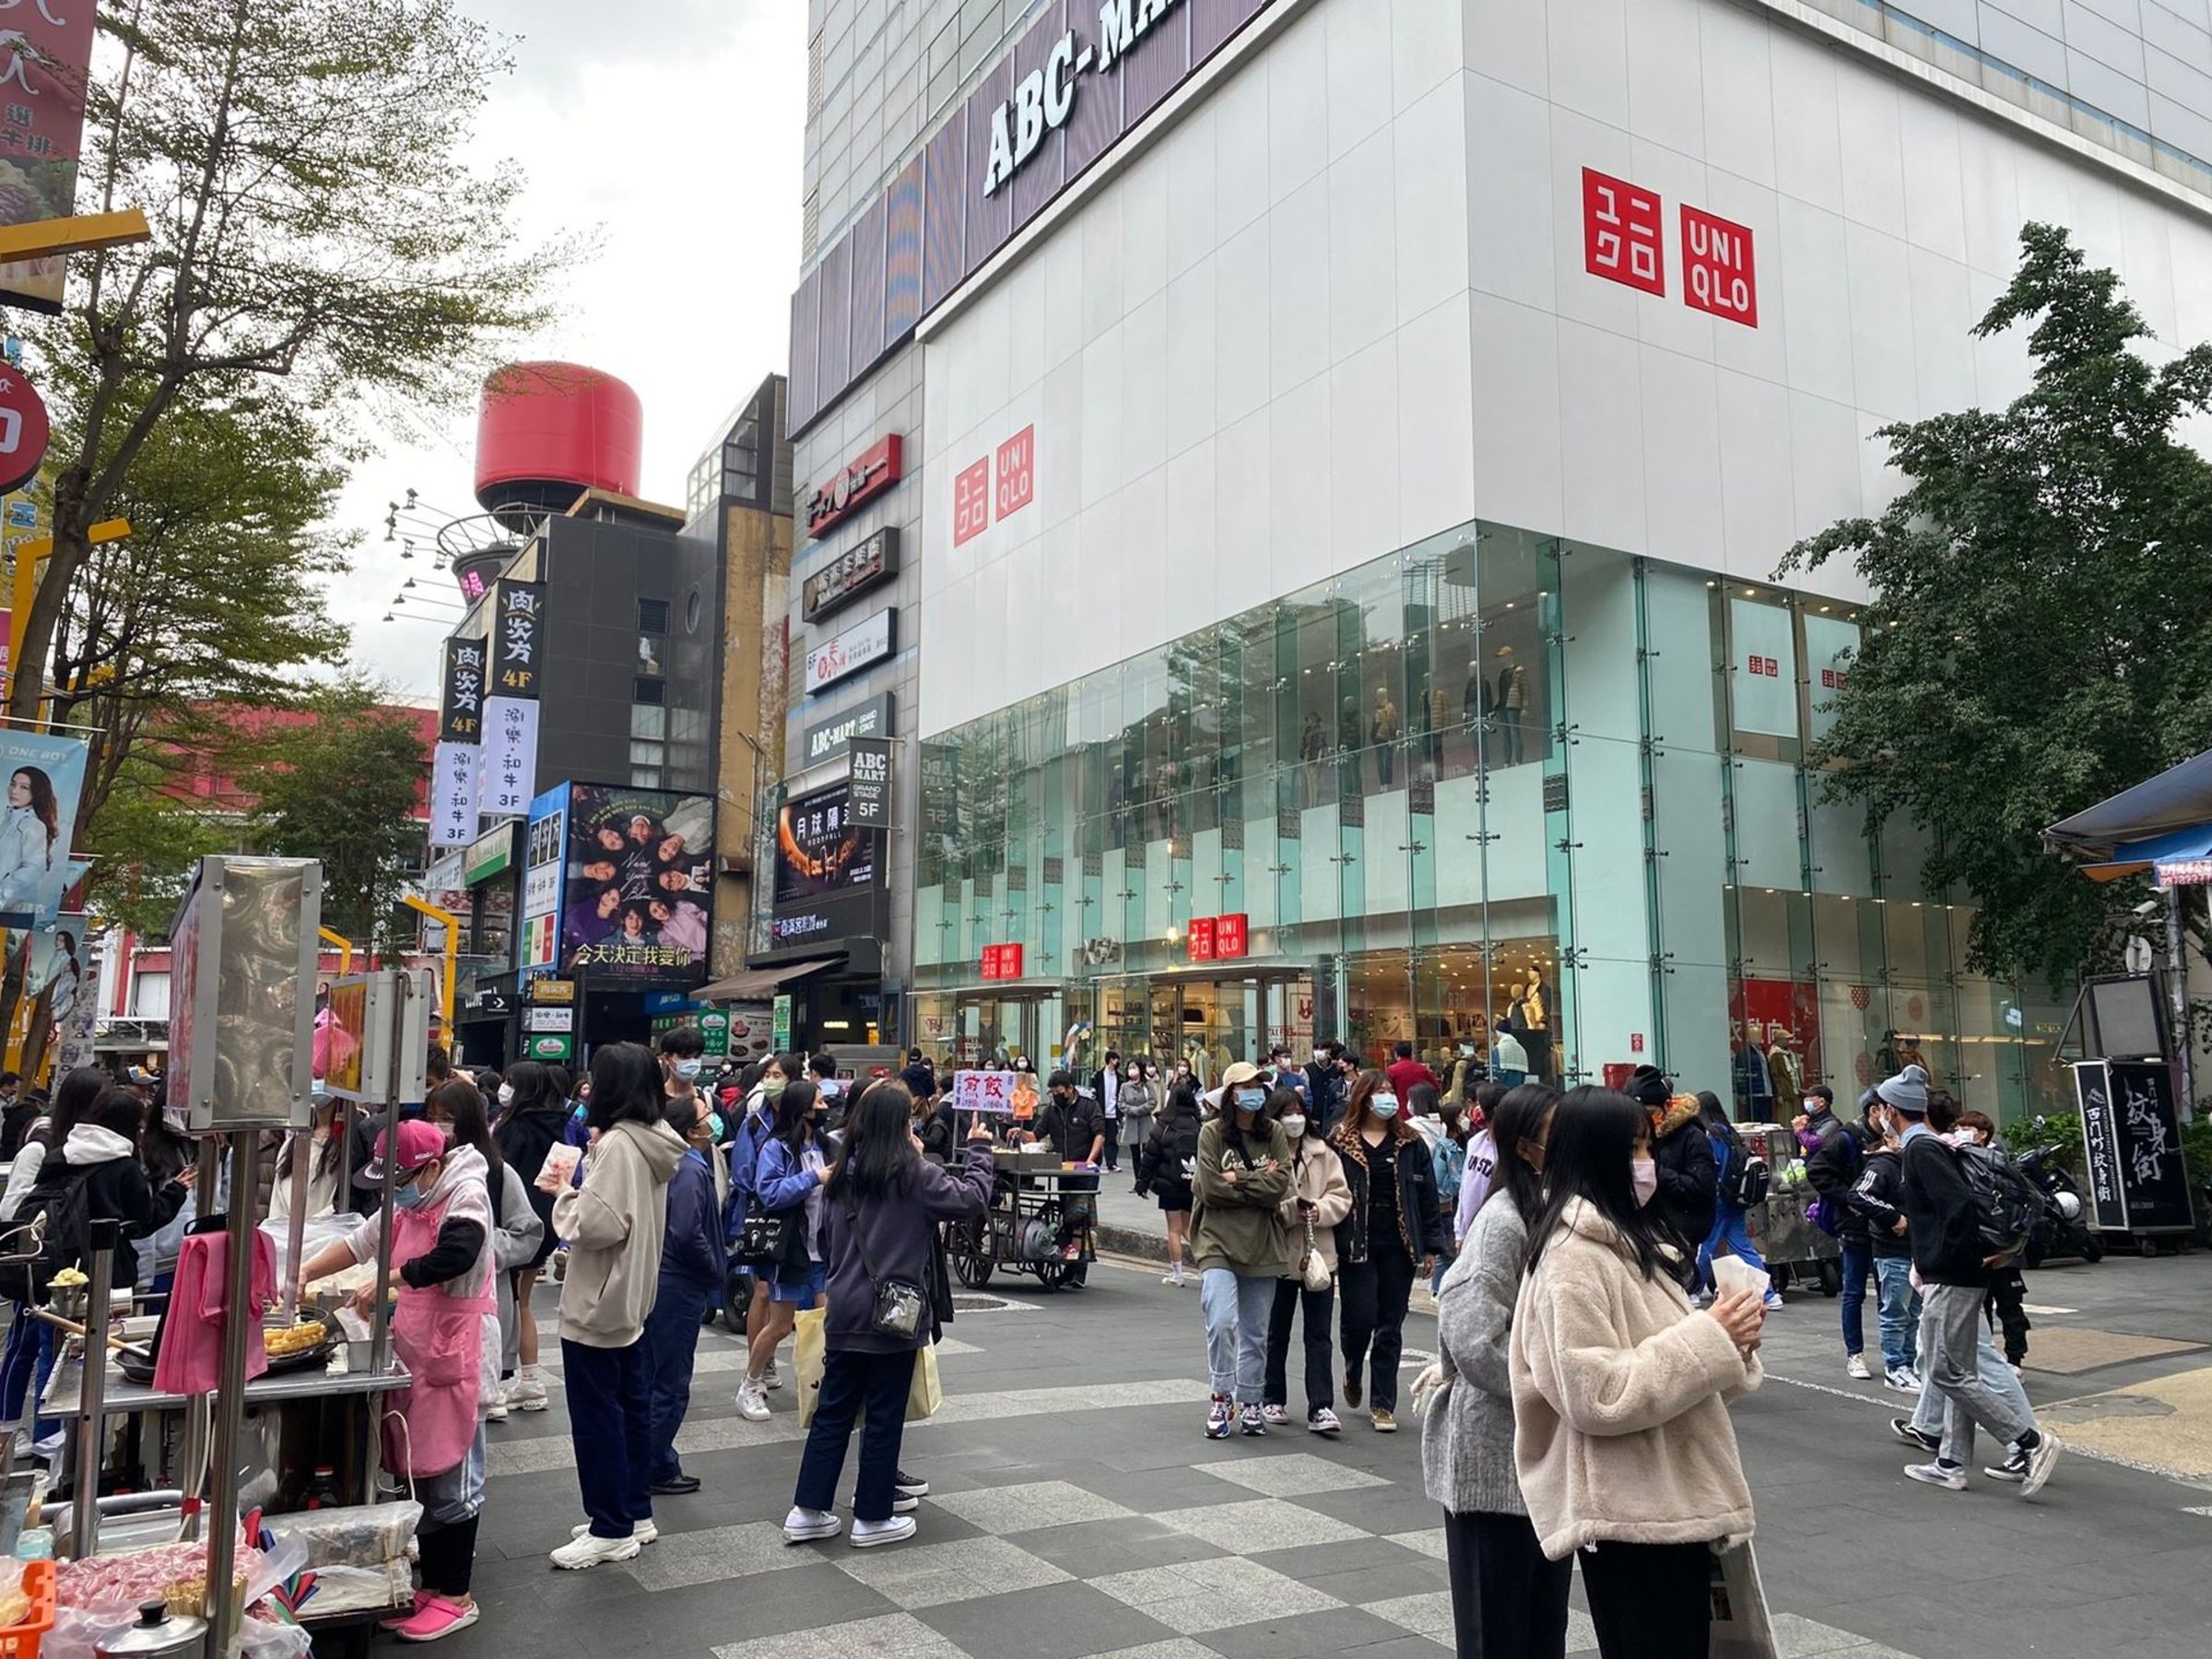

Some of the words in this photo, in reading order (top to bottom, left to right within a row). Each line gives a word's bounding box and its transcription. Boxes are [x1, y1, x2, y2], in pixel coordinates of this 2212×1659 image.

[1596, 185, 1654, 238] ユニ
[1595, 229, 1655, 281] クロ
[1689, 219, 1742, 271] UNI
[1691, 264, 1749, 312] QLO
[1000, 439, 1027, 477] UNI
[959, 468, 984, 505] ユニ
[1000, 470, 1029, 512] QLO
[959, 499, 983, 535] クロ
[503, 590, 536, 664] 肉次方
[453, 646, 481, 712] 肉次方
[501, 668, 533, 688] 4F
[451, 716, 478, 734] 4F
[853, 751, 886, 770] ABC
[853, 768, 887, 782] MART
[499, 794, 520, 807] 3F
[853, 783, 881, 794] GRAND
[853, 791, 878, 799] STAGE
[859, 803, 879, 817] 5F
[447, 829, 466, 840] 3F
[1218, 921, 1237, 935] UNI
[576, 943, 691, 967] 今天決定我愛你
[1218, 936, 1239, 954] QLO
[2086, 1106, 2112, 1203] 西門町紋身街
